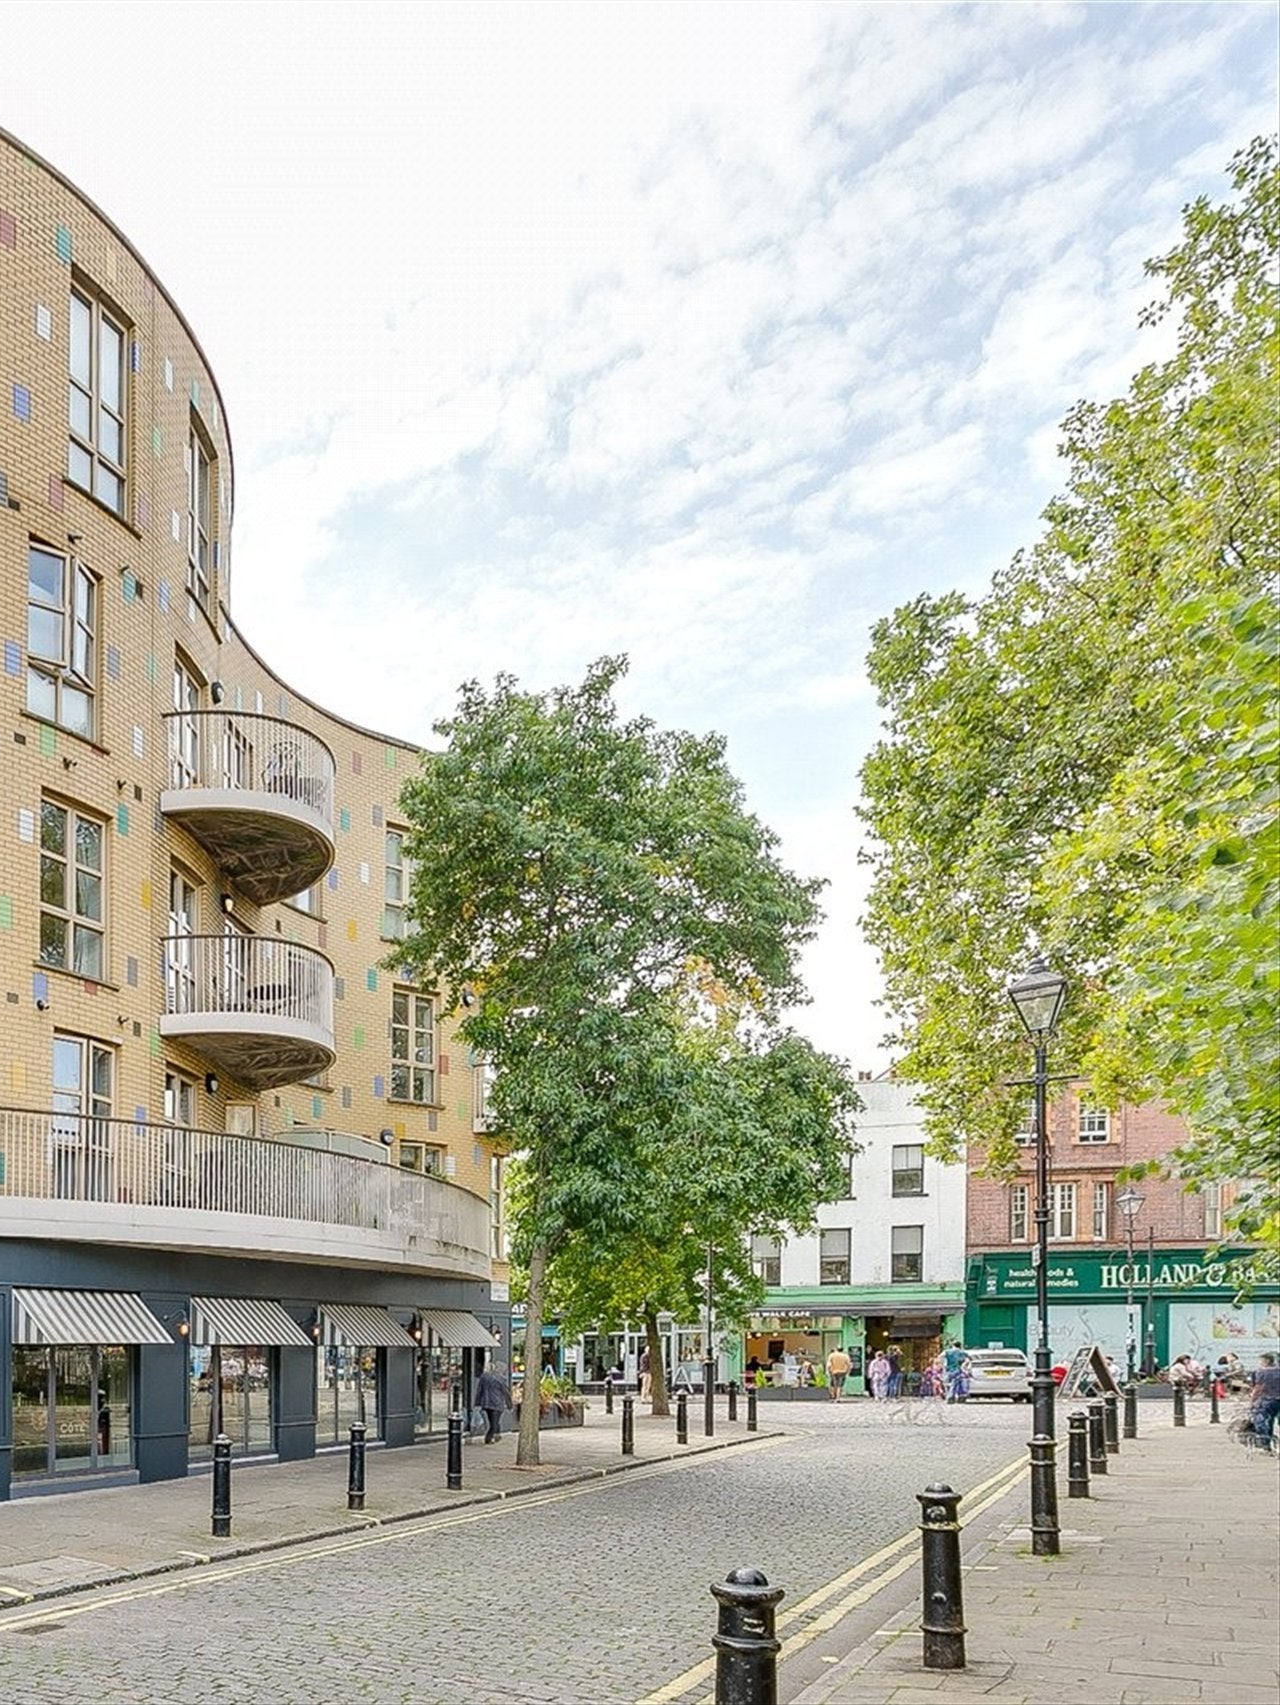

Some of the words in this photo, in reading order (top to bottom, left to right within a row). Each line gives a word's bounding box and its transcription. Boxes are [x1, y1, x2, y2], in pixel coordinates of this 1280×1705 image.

[1008, 1268, 1038, 1277] health
[1100, 1263, 1200, 1288] HOLLAND
[1206, 1263, 1226, 1286] &
[1003, 1279, 1037, 1288] natural
